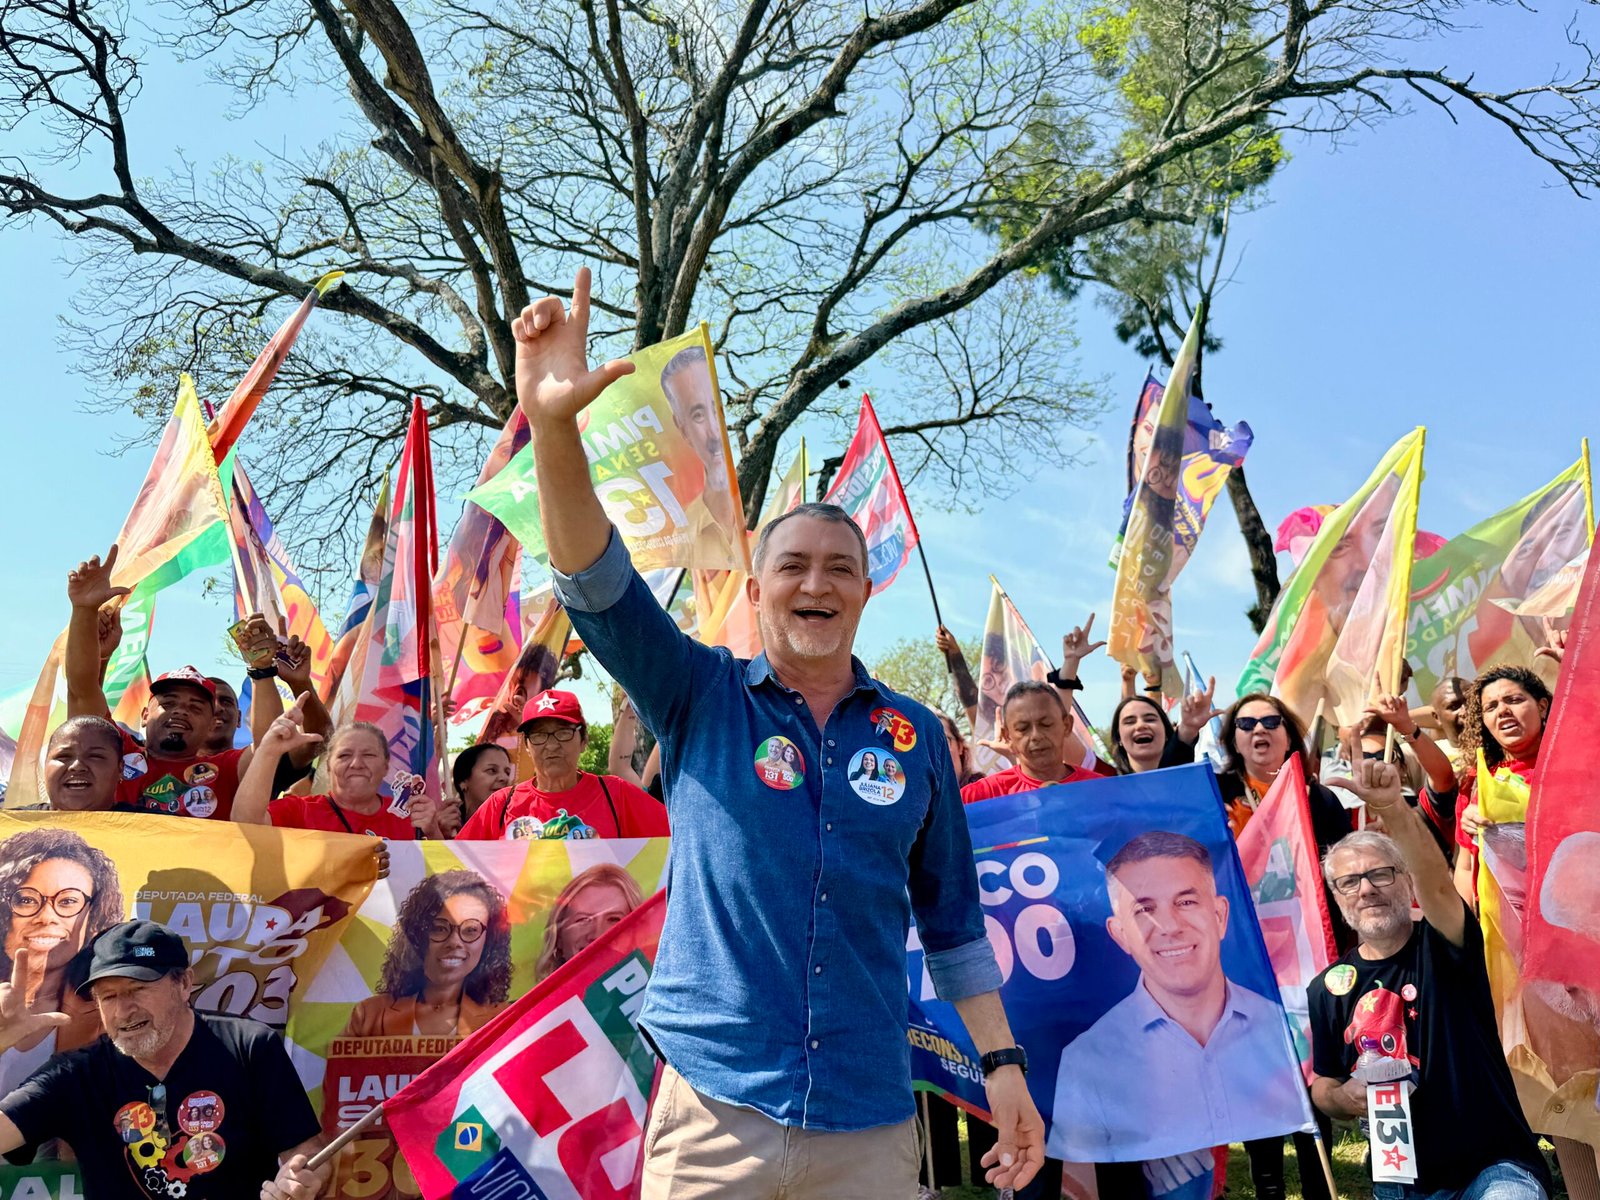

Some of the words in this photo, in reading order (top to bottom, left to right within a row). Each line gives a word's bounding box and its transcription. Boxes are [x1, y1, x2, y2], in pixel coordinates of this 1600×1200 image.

[890, 718, 915, 746] 13
[146, 781, 175, 795] LULA
[881, 786, 895, 800] 12
[976, 852, 1060, 906] CO
[135, 890, 206, 902] DEPUTADA
[208, 891, 266, 904] FEDERAL
[332, 1038, 415, 1056] DEPUTADA
[338, 1074, 422, 1102] LAU
[130, 1105, 154, 1129] 13
[492, 1018, 642, 1200] LU
[1389, 1152, 1398, 1165] PT
[0, 1173, 85, 1200] AL
